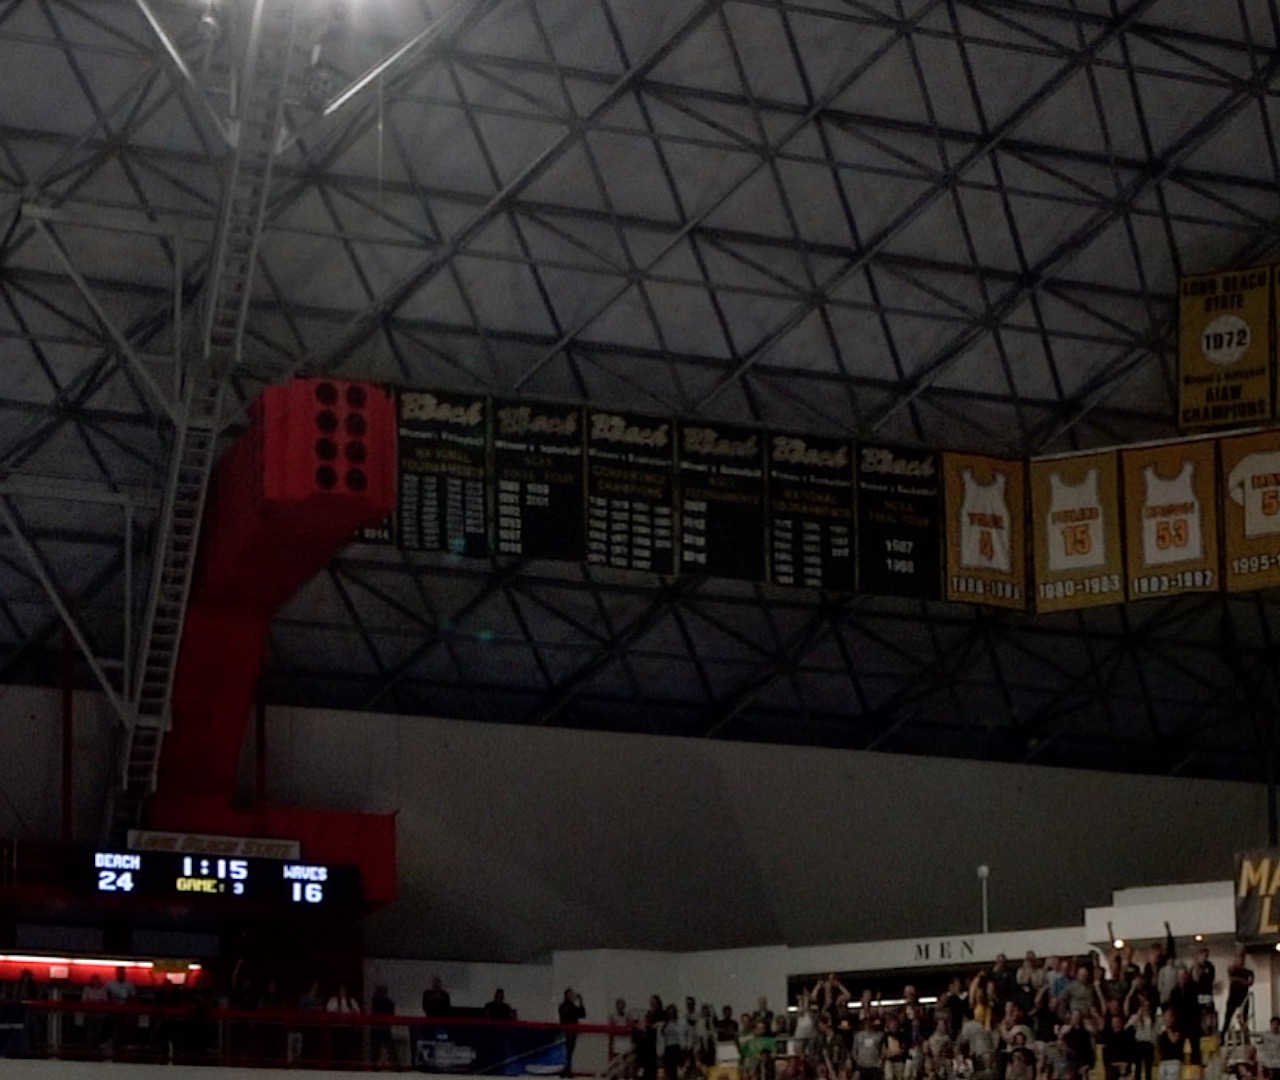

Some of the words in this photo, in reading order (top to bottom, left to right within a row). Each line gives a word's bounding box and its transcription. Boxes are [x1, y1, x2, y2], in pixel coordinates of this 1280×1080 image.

[1183, 279, 1217, 295] LONG
[1223, 272, 1266, 291] BEACH
[1204, 294, 1245, 313] STATE
[1204, 329, 1247, 350] 1972
[1206, 385, 1242, 401] AIAW
[1183, 400, 1265, 423] CHAMPIONS
[1261, 491, 1280, 516] 5
[1061, 525, 1091, 556] 15
[1155, 520, 1188, 549] 53
[95, 853, 140, 870] BEACH
[183, 857, 248, 880] 1:15
[98, 871, 134, 891] 24
[283, 865, 328, 882] WAVES
[176, 877, 225, 893] GAME:
[233, 882, 245, 895] 3
[292, 882, 323, 903] 16
[915, 940, 976, 961] MEN
